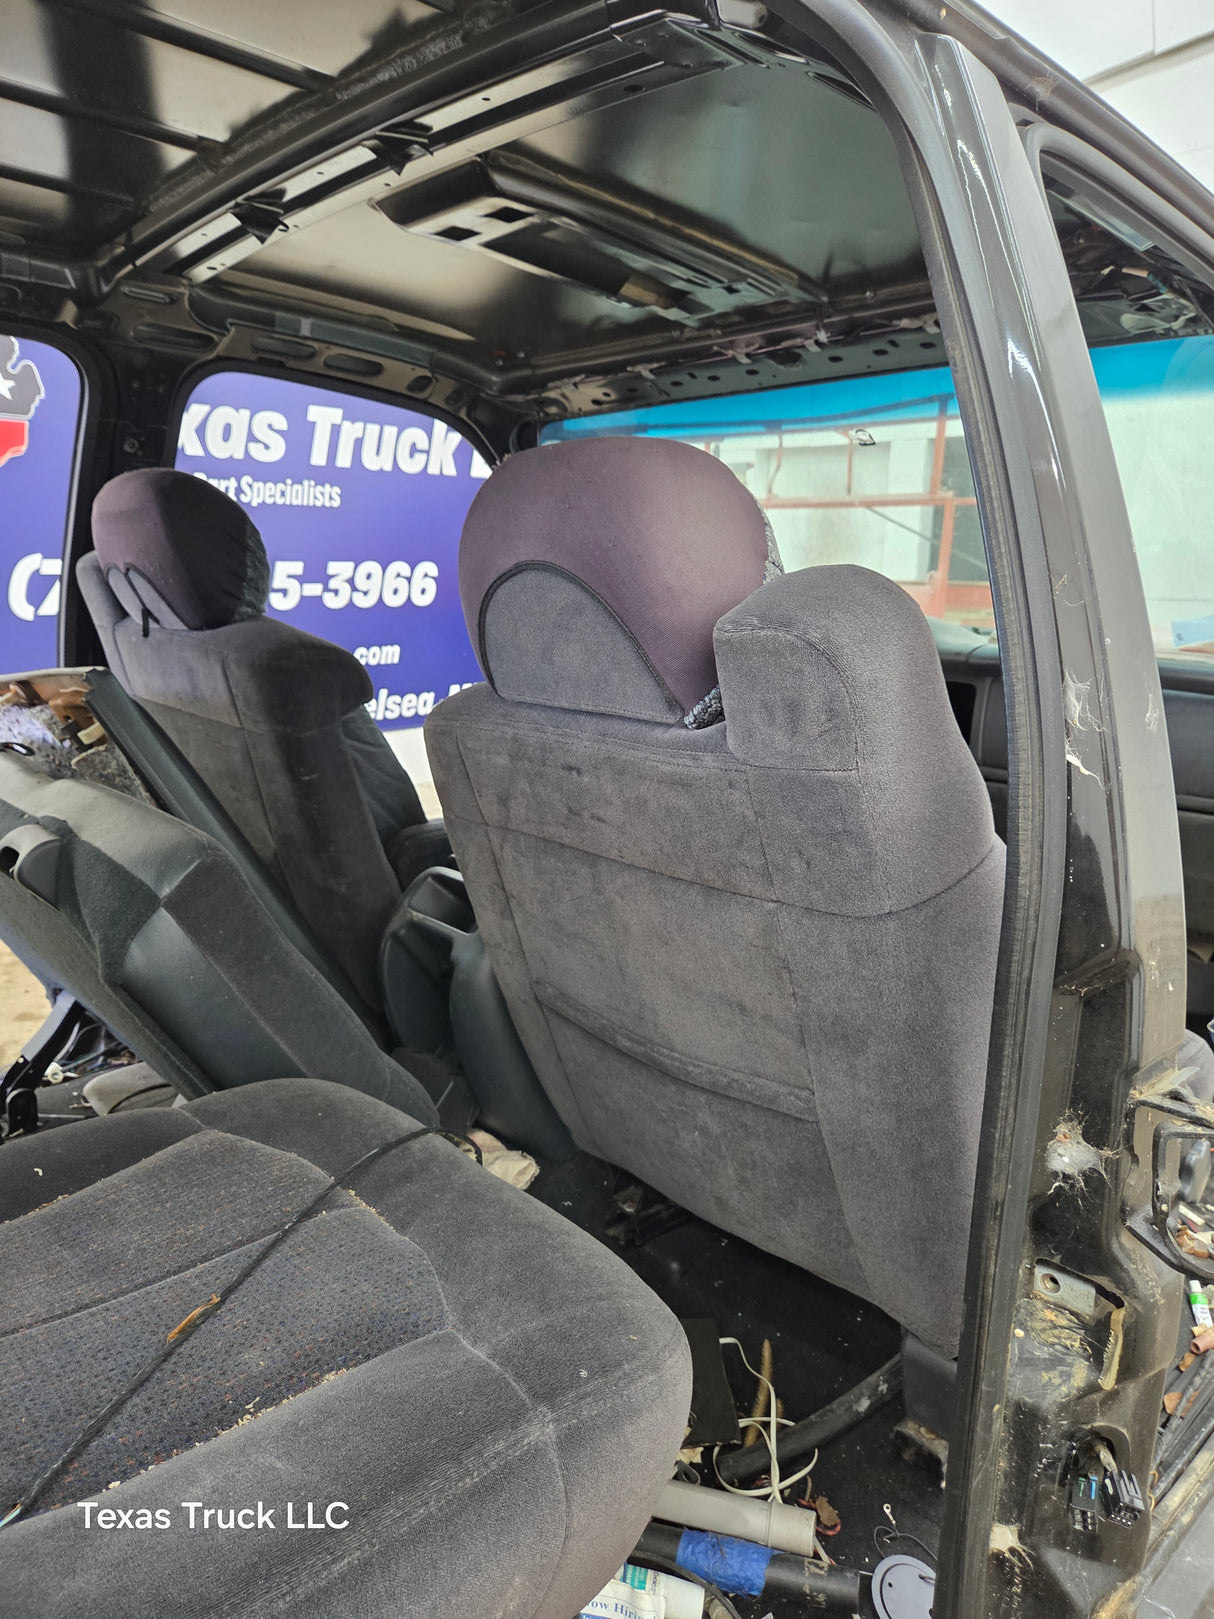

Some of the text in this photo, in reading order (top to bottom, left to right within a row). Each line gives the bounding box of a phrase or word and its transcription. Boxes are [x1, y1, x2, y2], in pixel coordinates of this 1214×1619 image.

[306, 405, 463, 476] Truck
[239, 475, 342, 508] Specialists
[268, 560, 439, 611] 5-3966
[587, 1600, 609, 1610] ow
